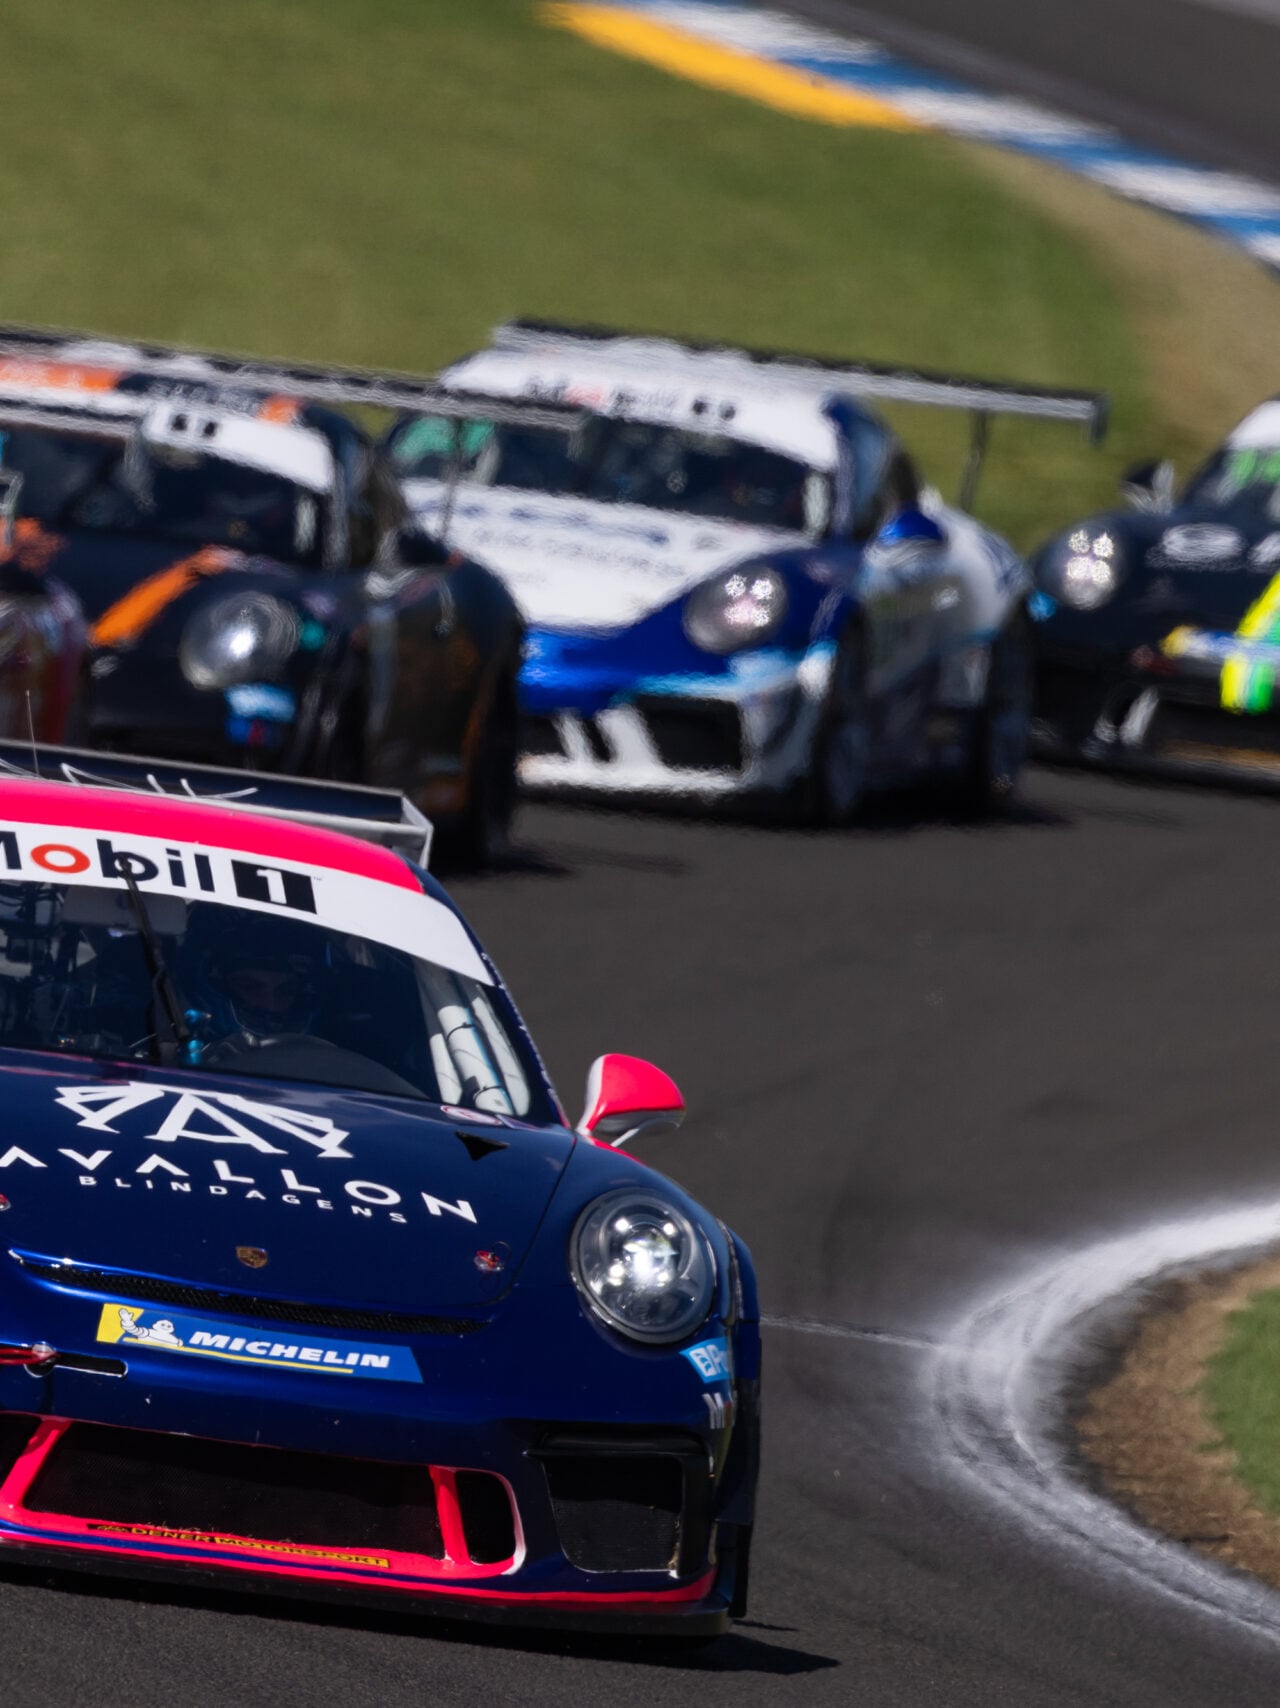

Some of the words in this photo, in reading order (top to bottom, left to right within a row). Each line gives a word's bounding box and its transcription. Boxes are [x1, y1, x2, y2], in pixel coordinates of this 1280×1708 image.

[78, 1174, 408, 1224] BLINDAGENS
[188, 1331, 390, 1368] MICHELIN
[131, 1527, 211, 1543] DENER
[217, 1537, 387, 1567] MOTORSPORT
